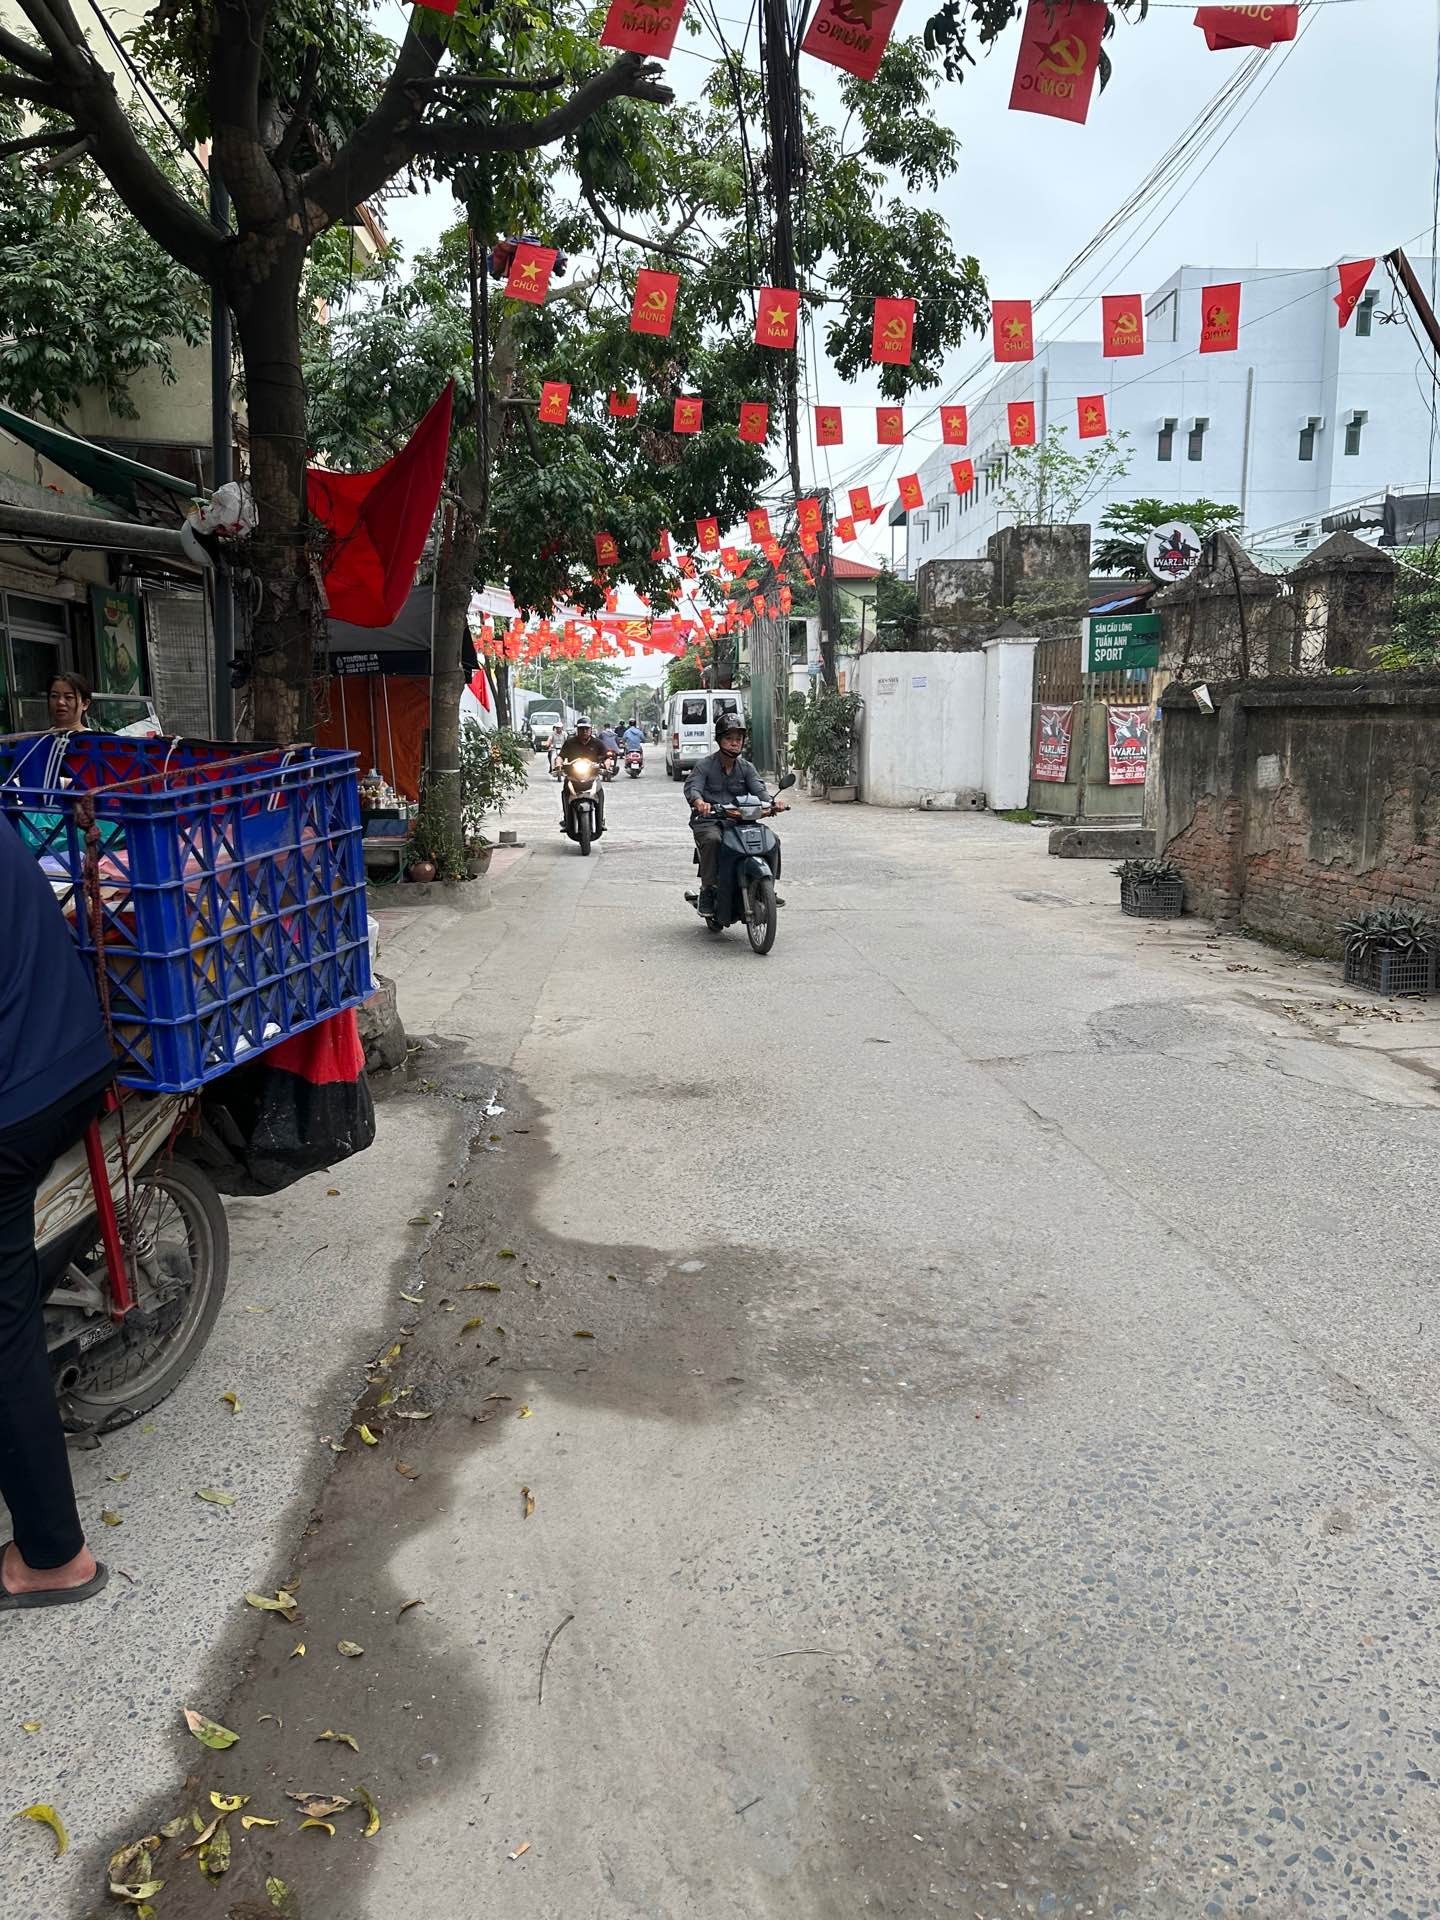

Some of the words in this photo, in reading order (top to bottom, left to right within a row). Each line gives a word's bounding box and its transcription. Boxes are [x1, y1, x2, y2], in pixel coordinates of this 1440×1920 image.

[512, 279, 540, 293] CHÚC
[767, 326, 789, 337] NĂM
[1095, 634, 1113, 648] TUẤN
[1113, 635, 1128, 646] ANH
[1094, 647, 1124, 662] SPORT
